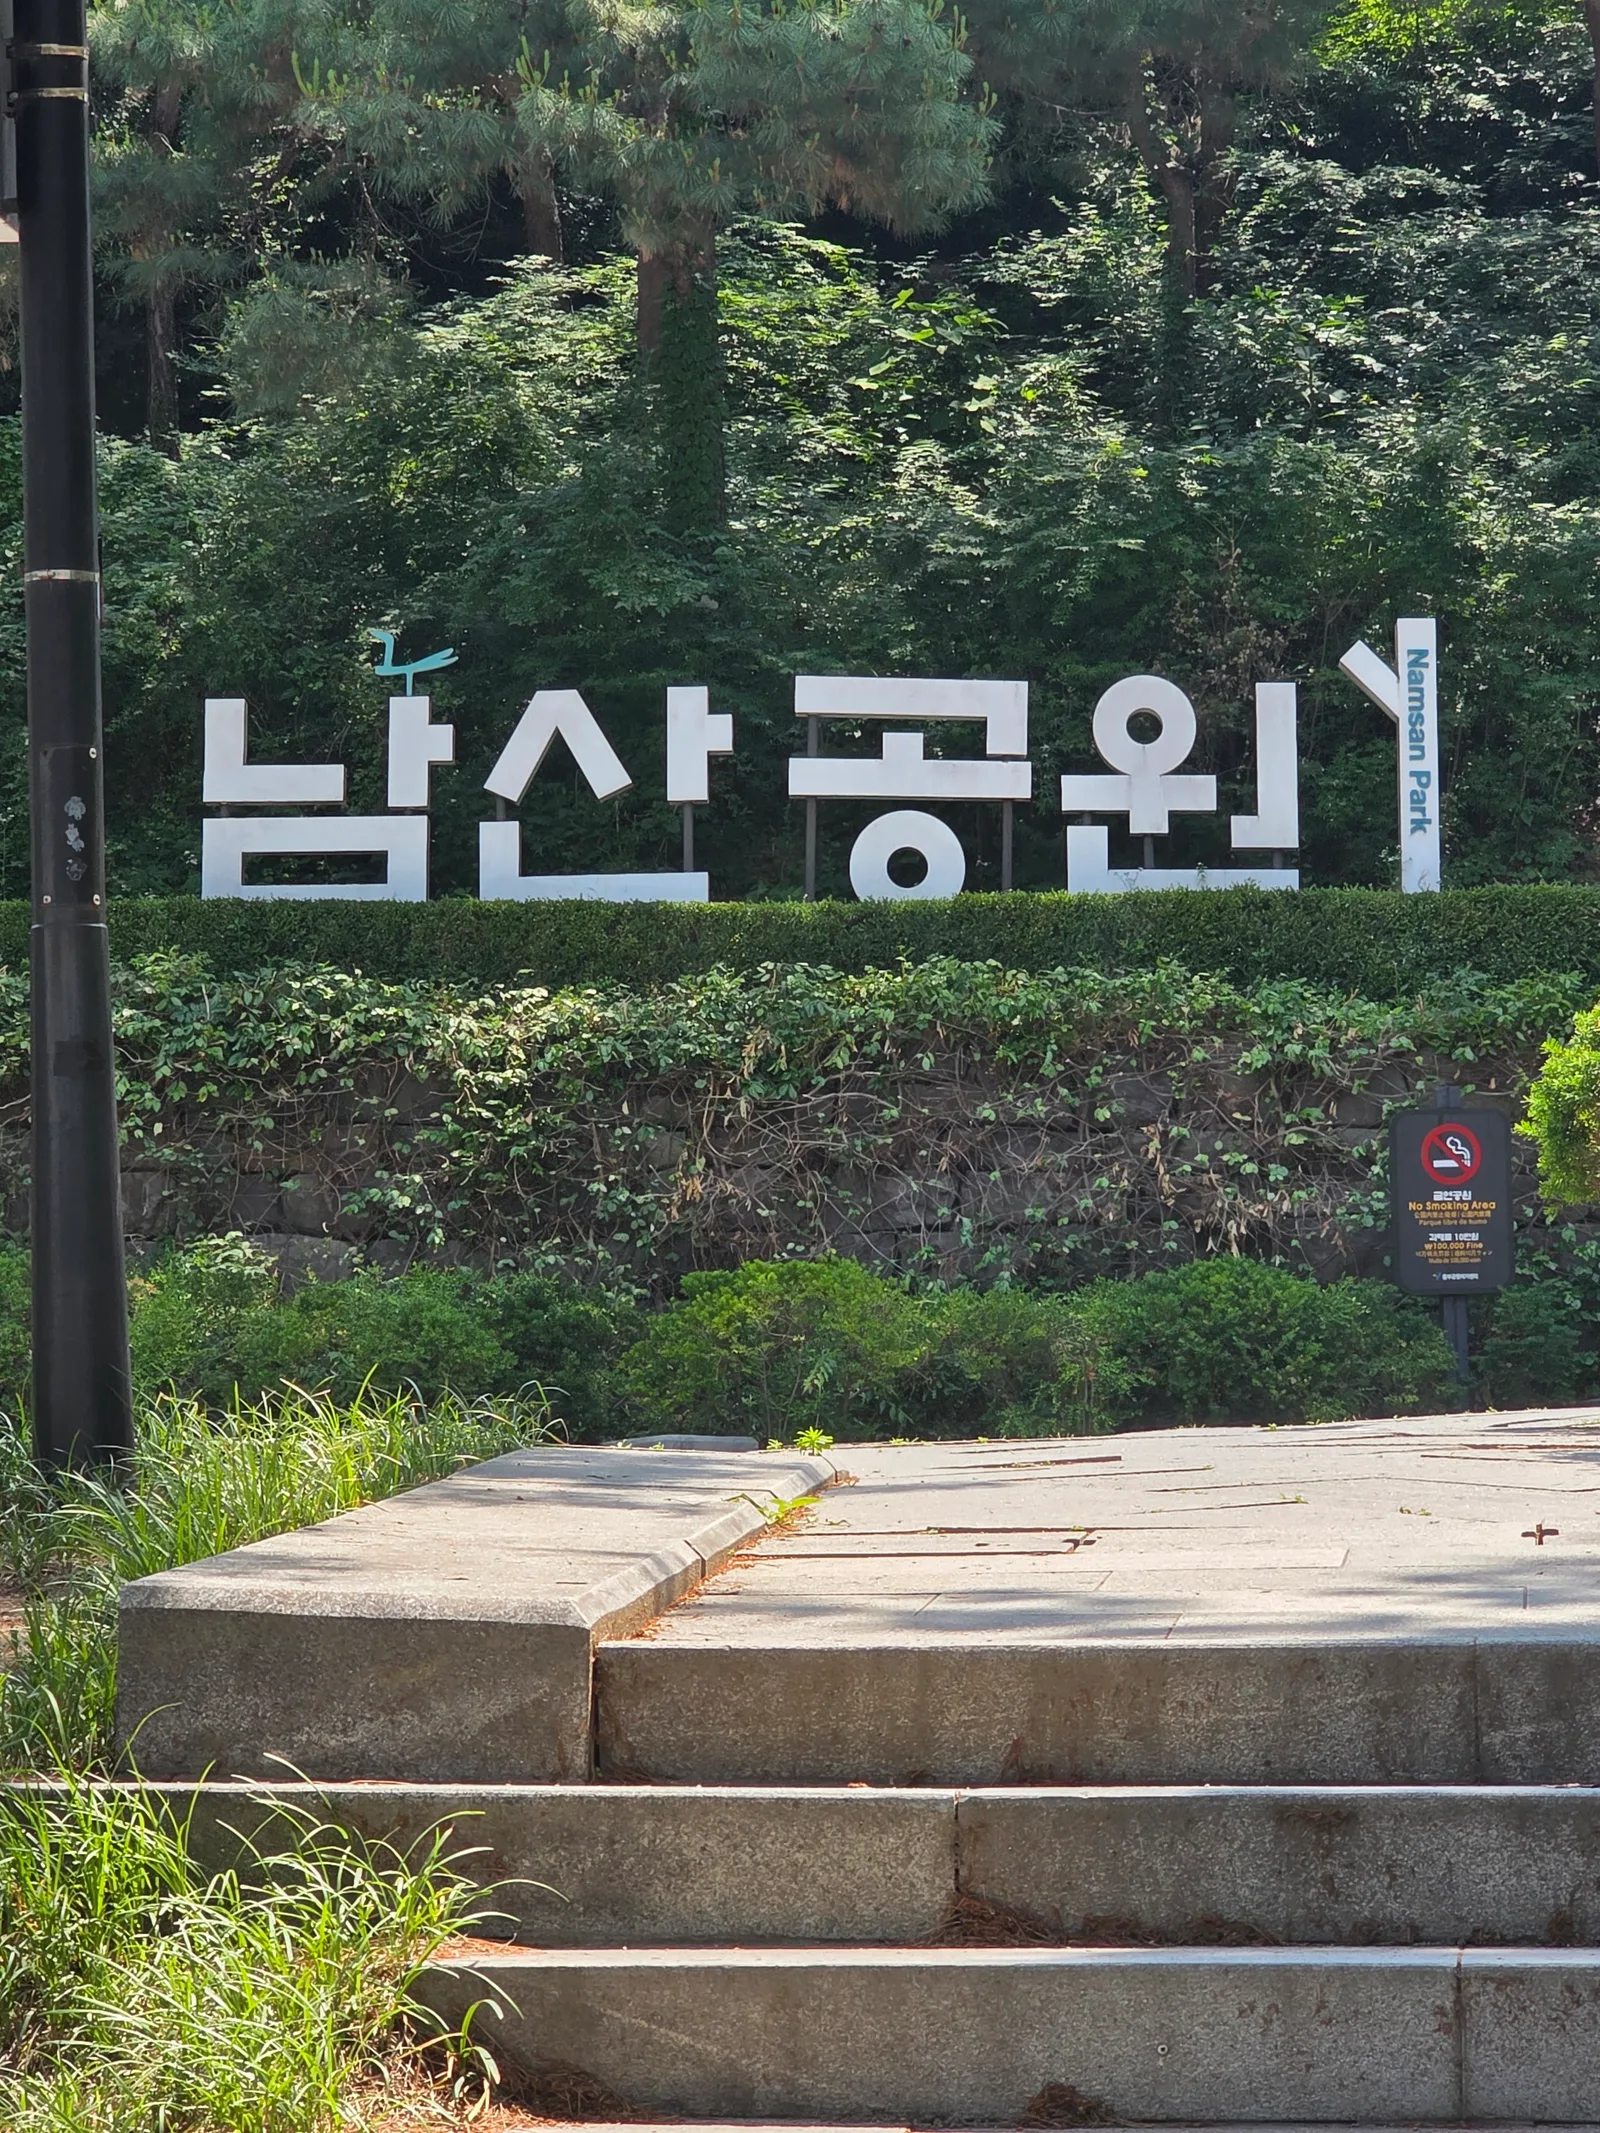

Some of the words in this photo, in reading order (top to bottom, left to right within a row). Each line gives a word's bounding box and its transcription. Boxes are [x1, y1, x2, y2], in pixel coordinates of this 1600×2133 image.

[1407, 648, 1430, 761] Namsan
[1409, 770, 1432, 836] Park
[1433, 1190, 1472, 1201] 금연공원
[1408, 1201, 1423, 1211] No
[1425, 1201, 1469, 1211] Smoking
[1471, 1200, 1496, 1210] Area
[1466, 1242, 1483, 1250] Fine
